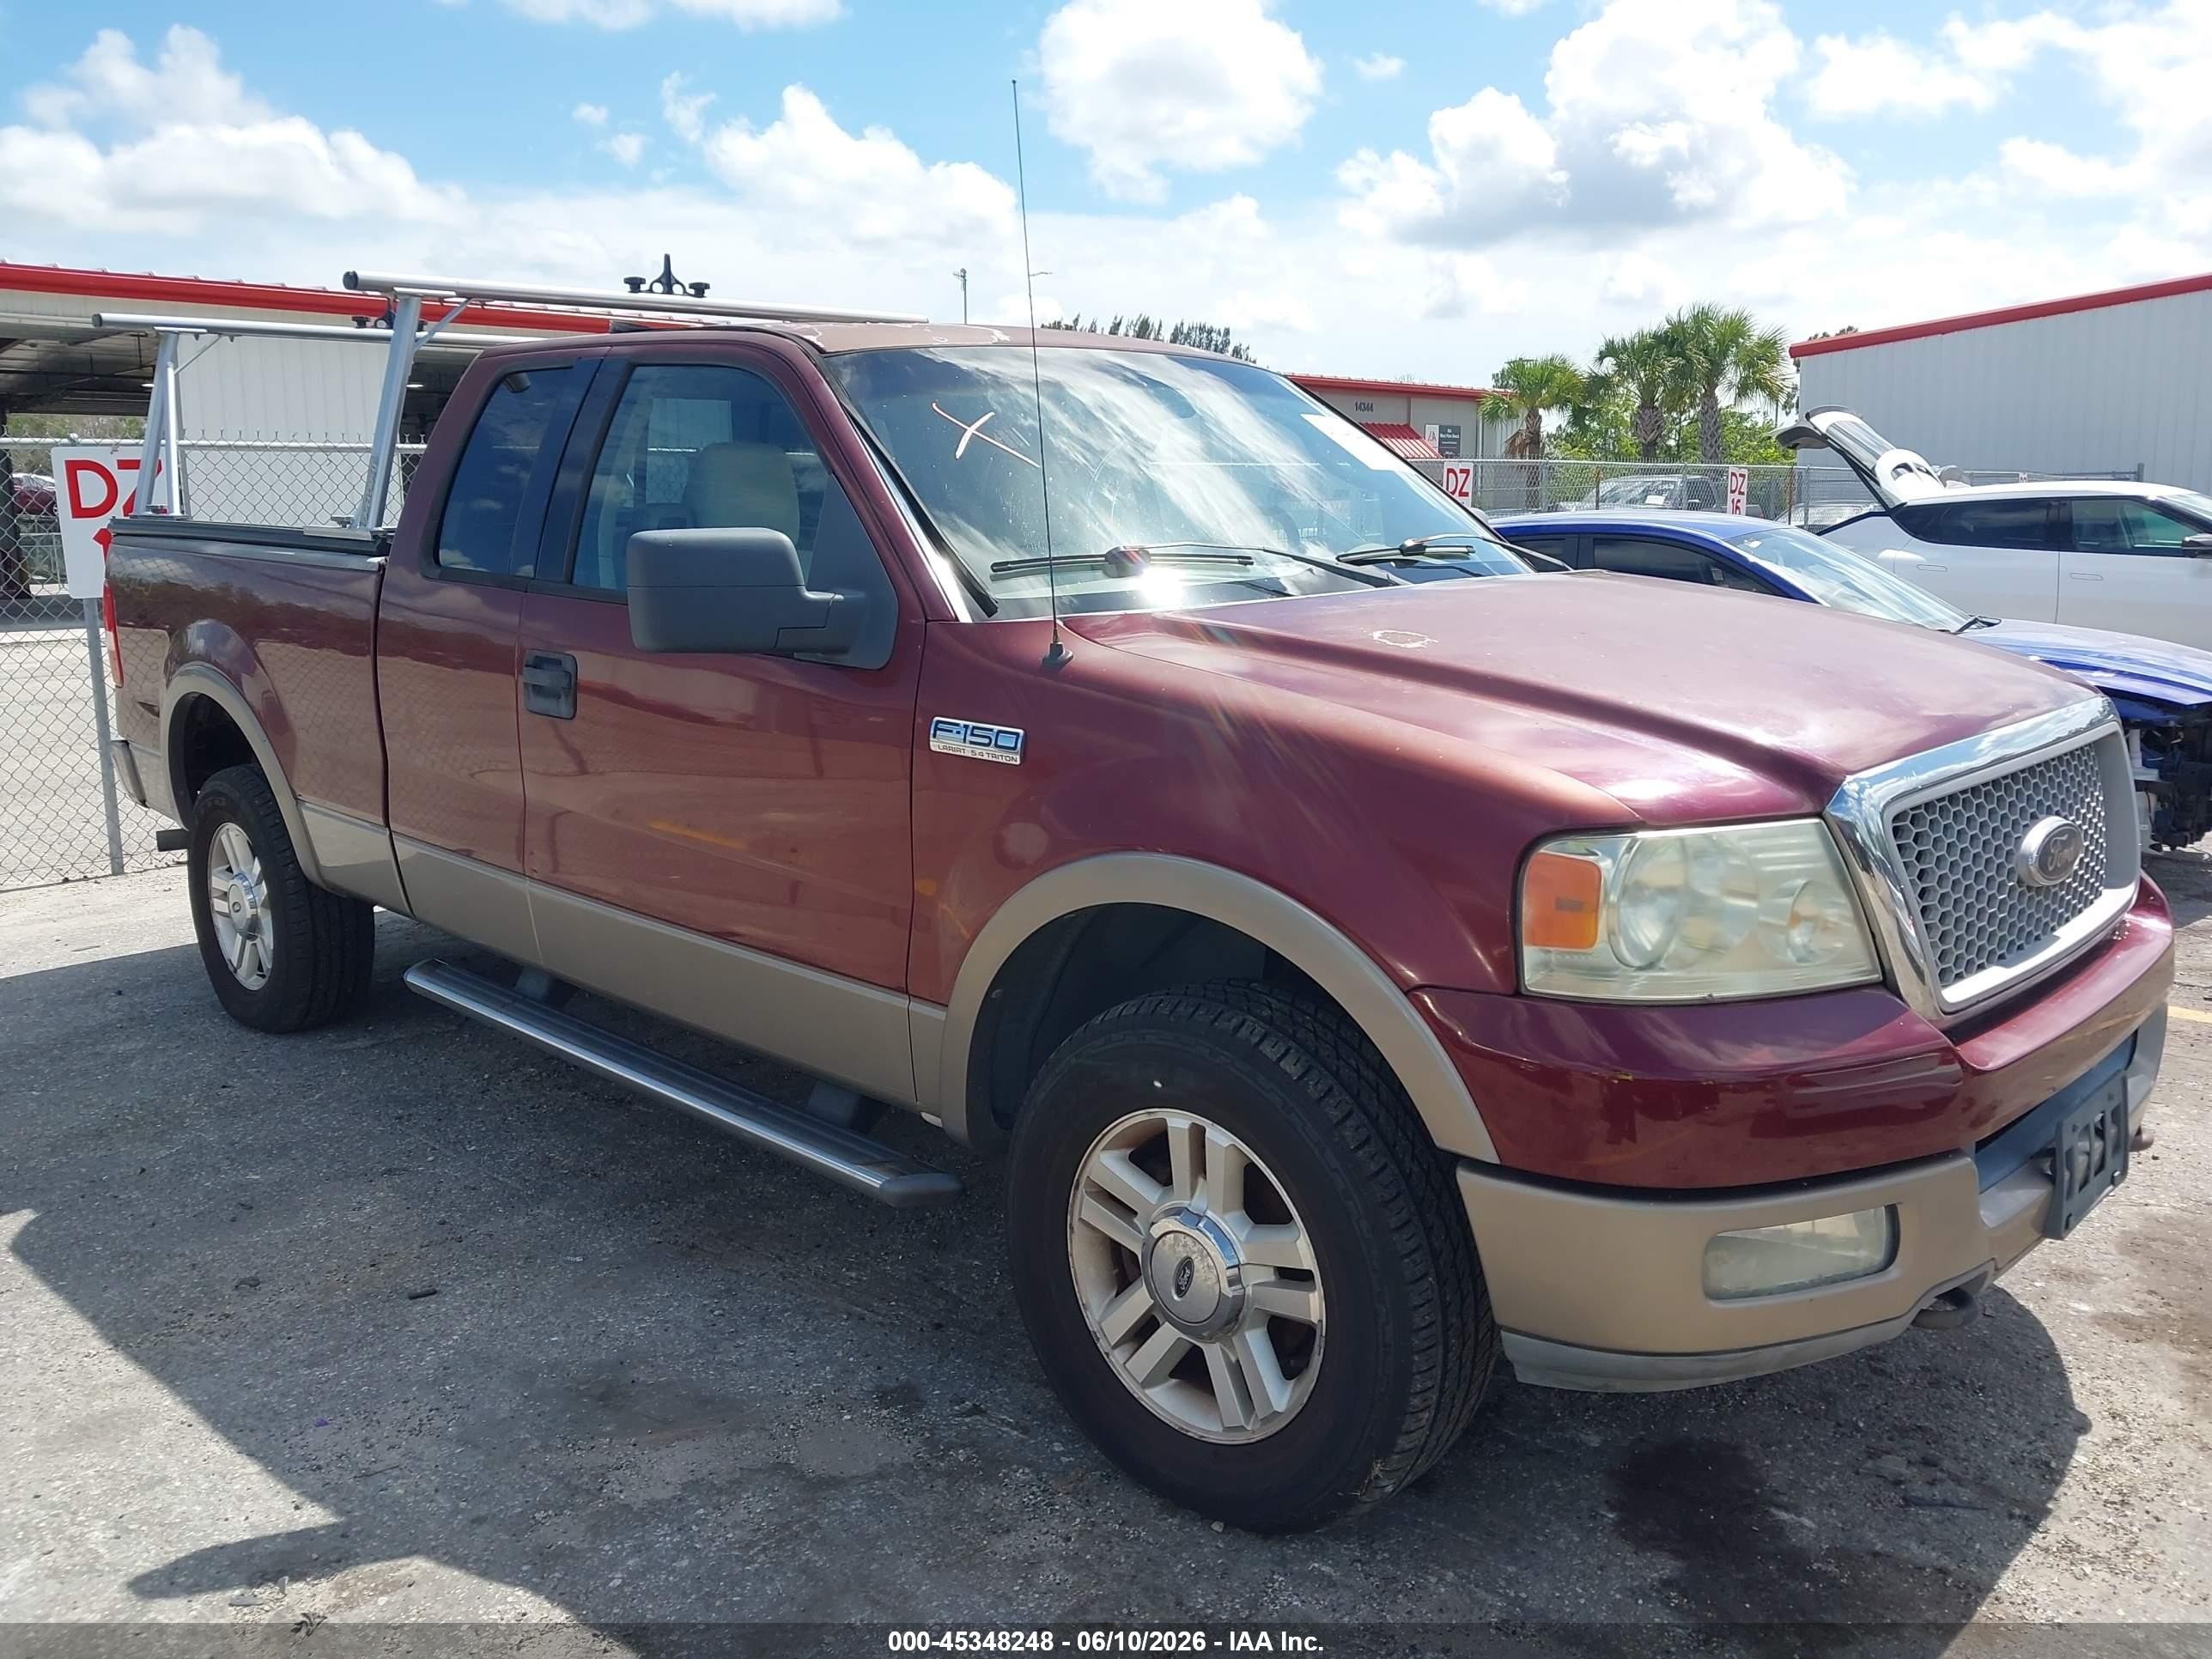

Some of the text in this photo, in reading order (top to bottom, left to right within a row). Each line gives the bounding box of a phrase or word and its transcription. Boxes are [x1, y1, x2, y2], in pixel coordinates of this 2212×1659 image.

[1445, 467, 1471, 497] DZ
[1729, 471, 1747, 496] DZ
[1731, 497, 1741, 515] 16
[932, 720, 1021, 751] F-150
[937, 744, 967, 755] LARIAT
[985, 752, 1018, 763] TRITON
[2047, 833, 2077, 872] Ford
[1177, 1266, 1192, 1291] Ford
